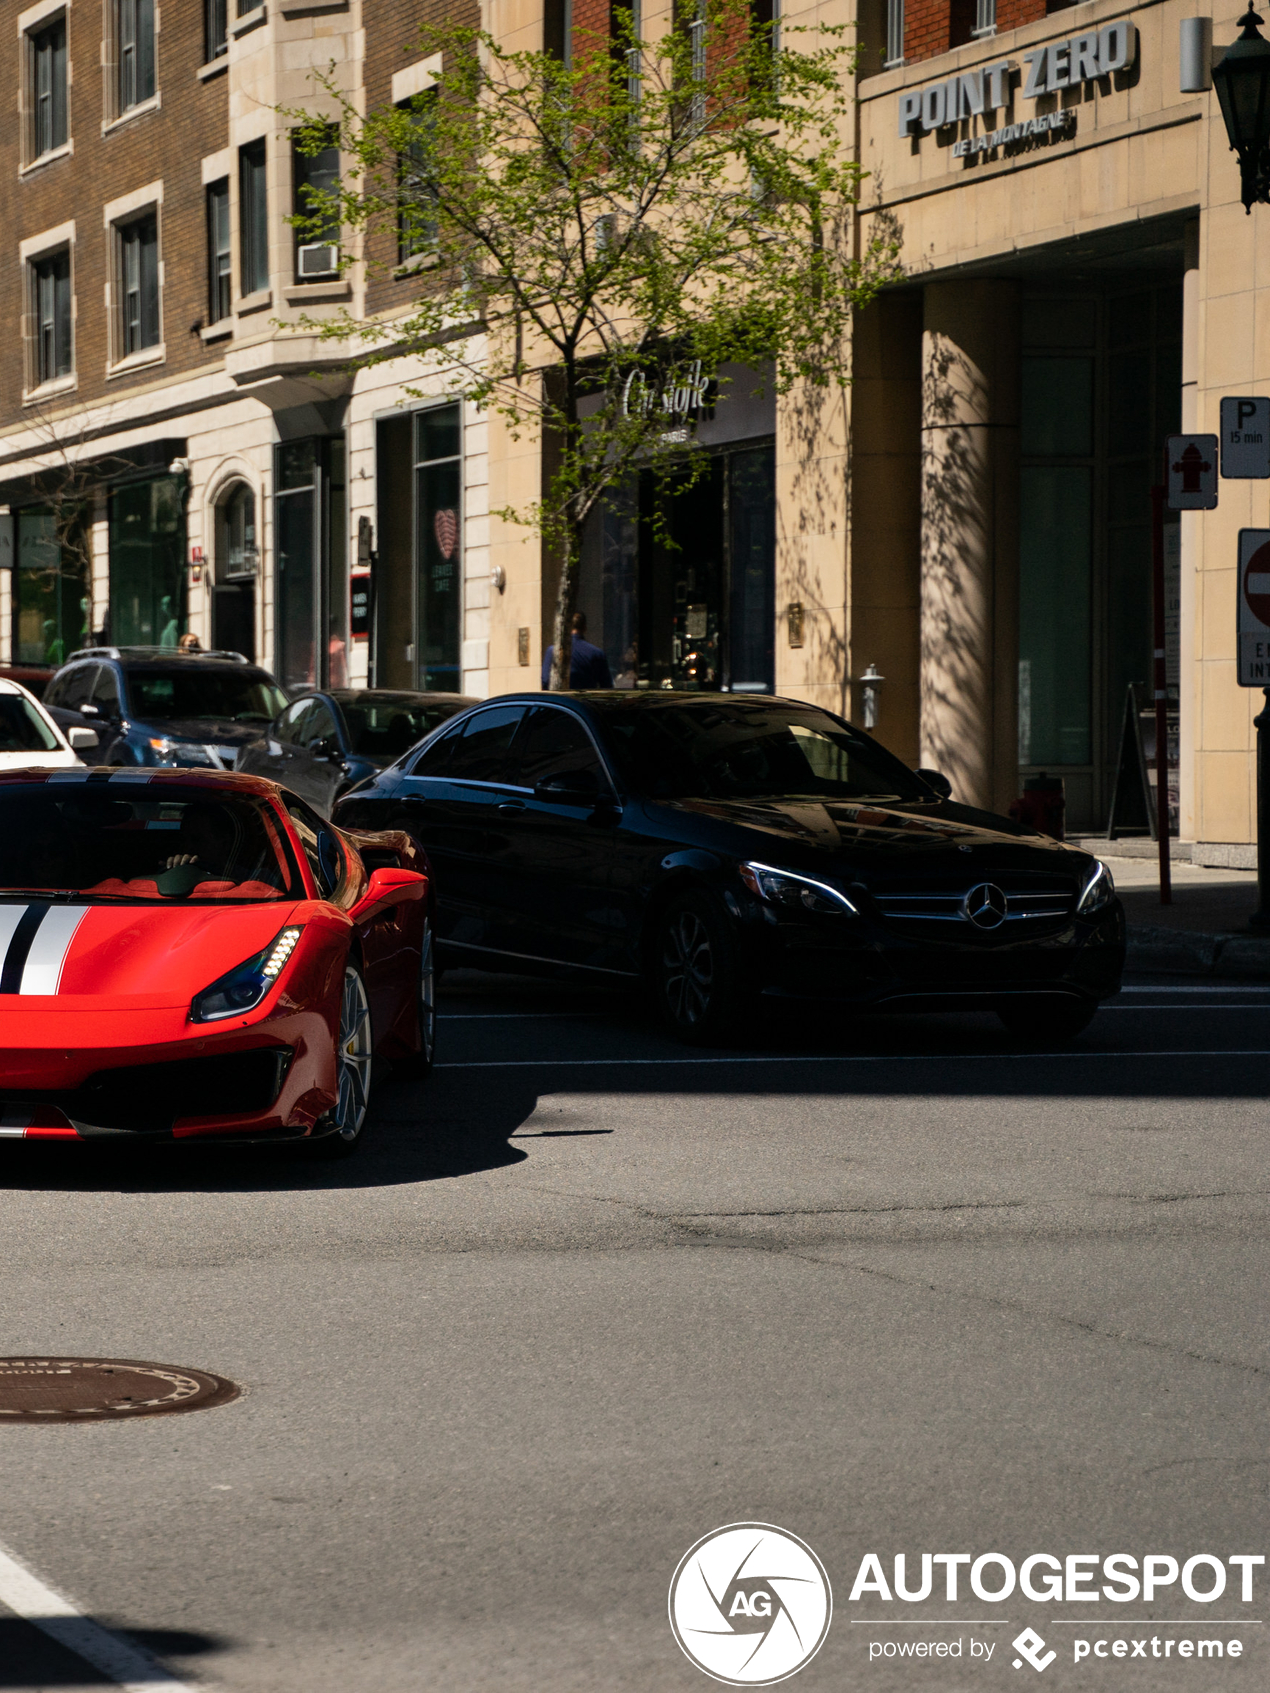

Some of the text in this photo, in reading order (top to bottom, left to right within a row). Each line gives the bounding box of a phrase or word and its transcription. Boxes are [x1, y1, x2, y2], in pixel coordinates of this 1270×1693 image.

[899, 21, 1135, 138] POINT ZERO
[952, 109, 1070, 158] DE LA MONTAGNE
[1238, 401, 1257, 429] P
[1230, 431, 1263, 443] 15 min
[1256, 643, 1270, 658] E
